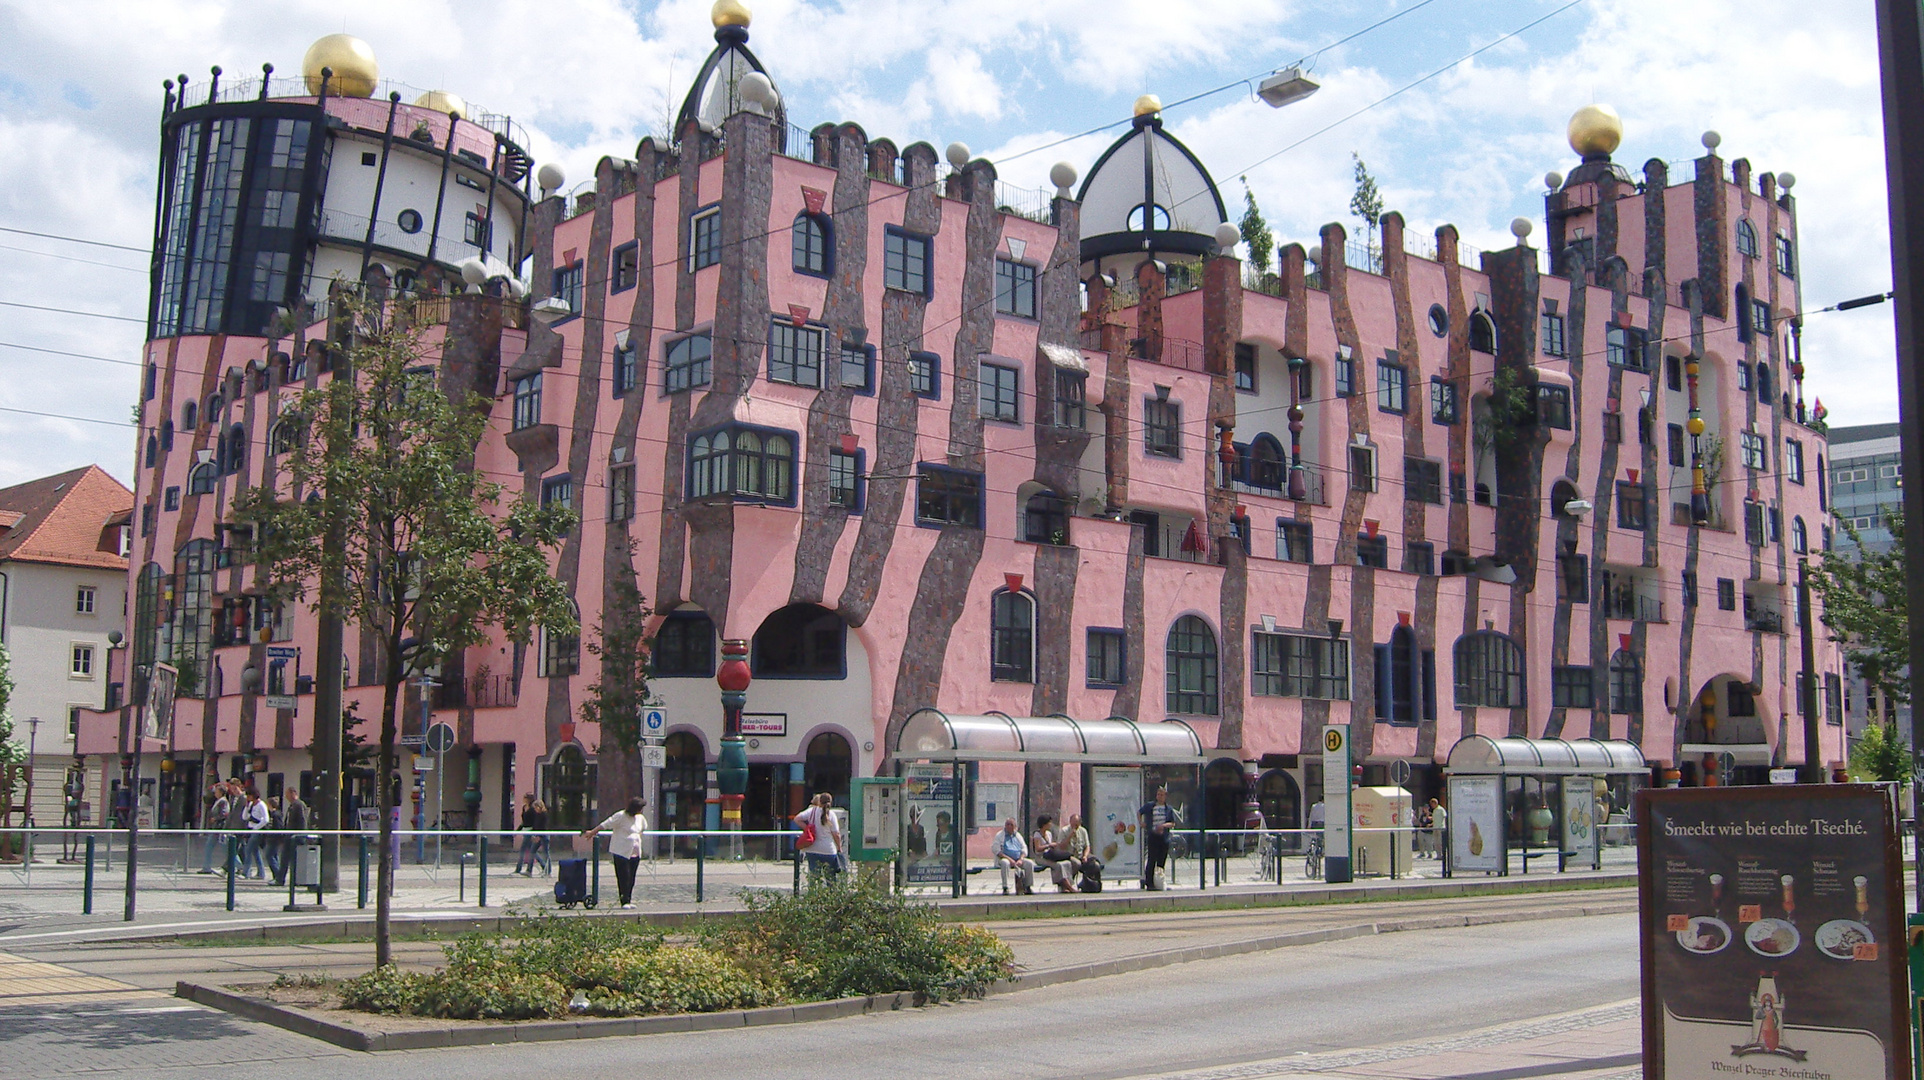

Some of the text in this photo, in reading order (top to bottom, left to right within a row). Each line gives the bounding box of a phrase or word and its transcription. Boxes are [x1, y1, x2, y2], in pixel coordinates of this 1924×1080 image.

[1664, 817, 1716, 836] Šmeckt
[1718, 821, 1743, 836] wie
[1745, 819, 1767, 836] bei
[1770, 819, 1808, 835] echte
[1711, 1061, 1743, 1074] Wenzel
[1745, 1064, 1777, 1078] Prager
